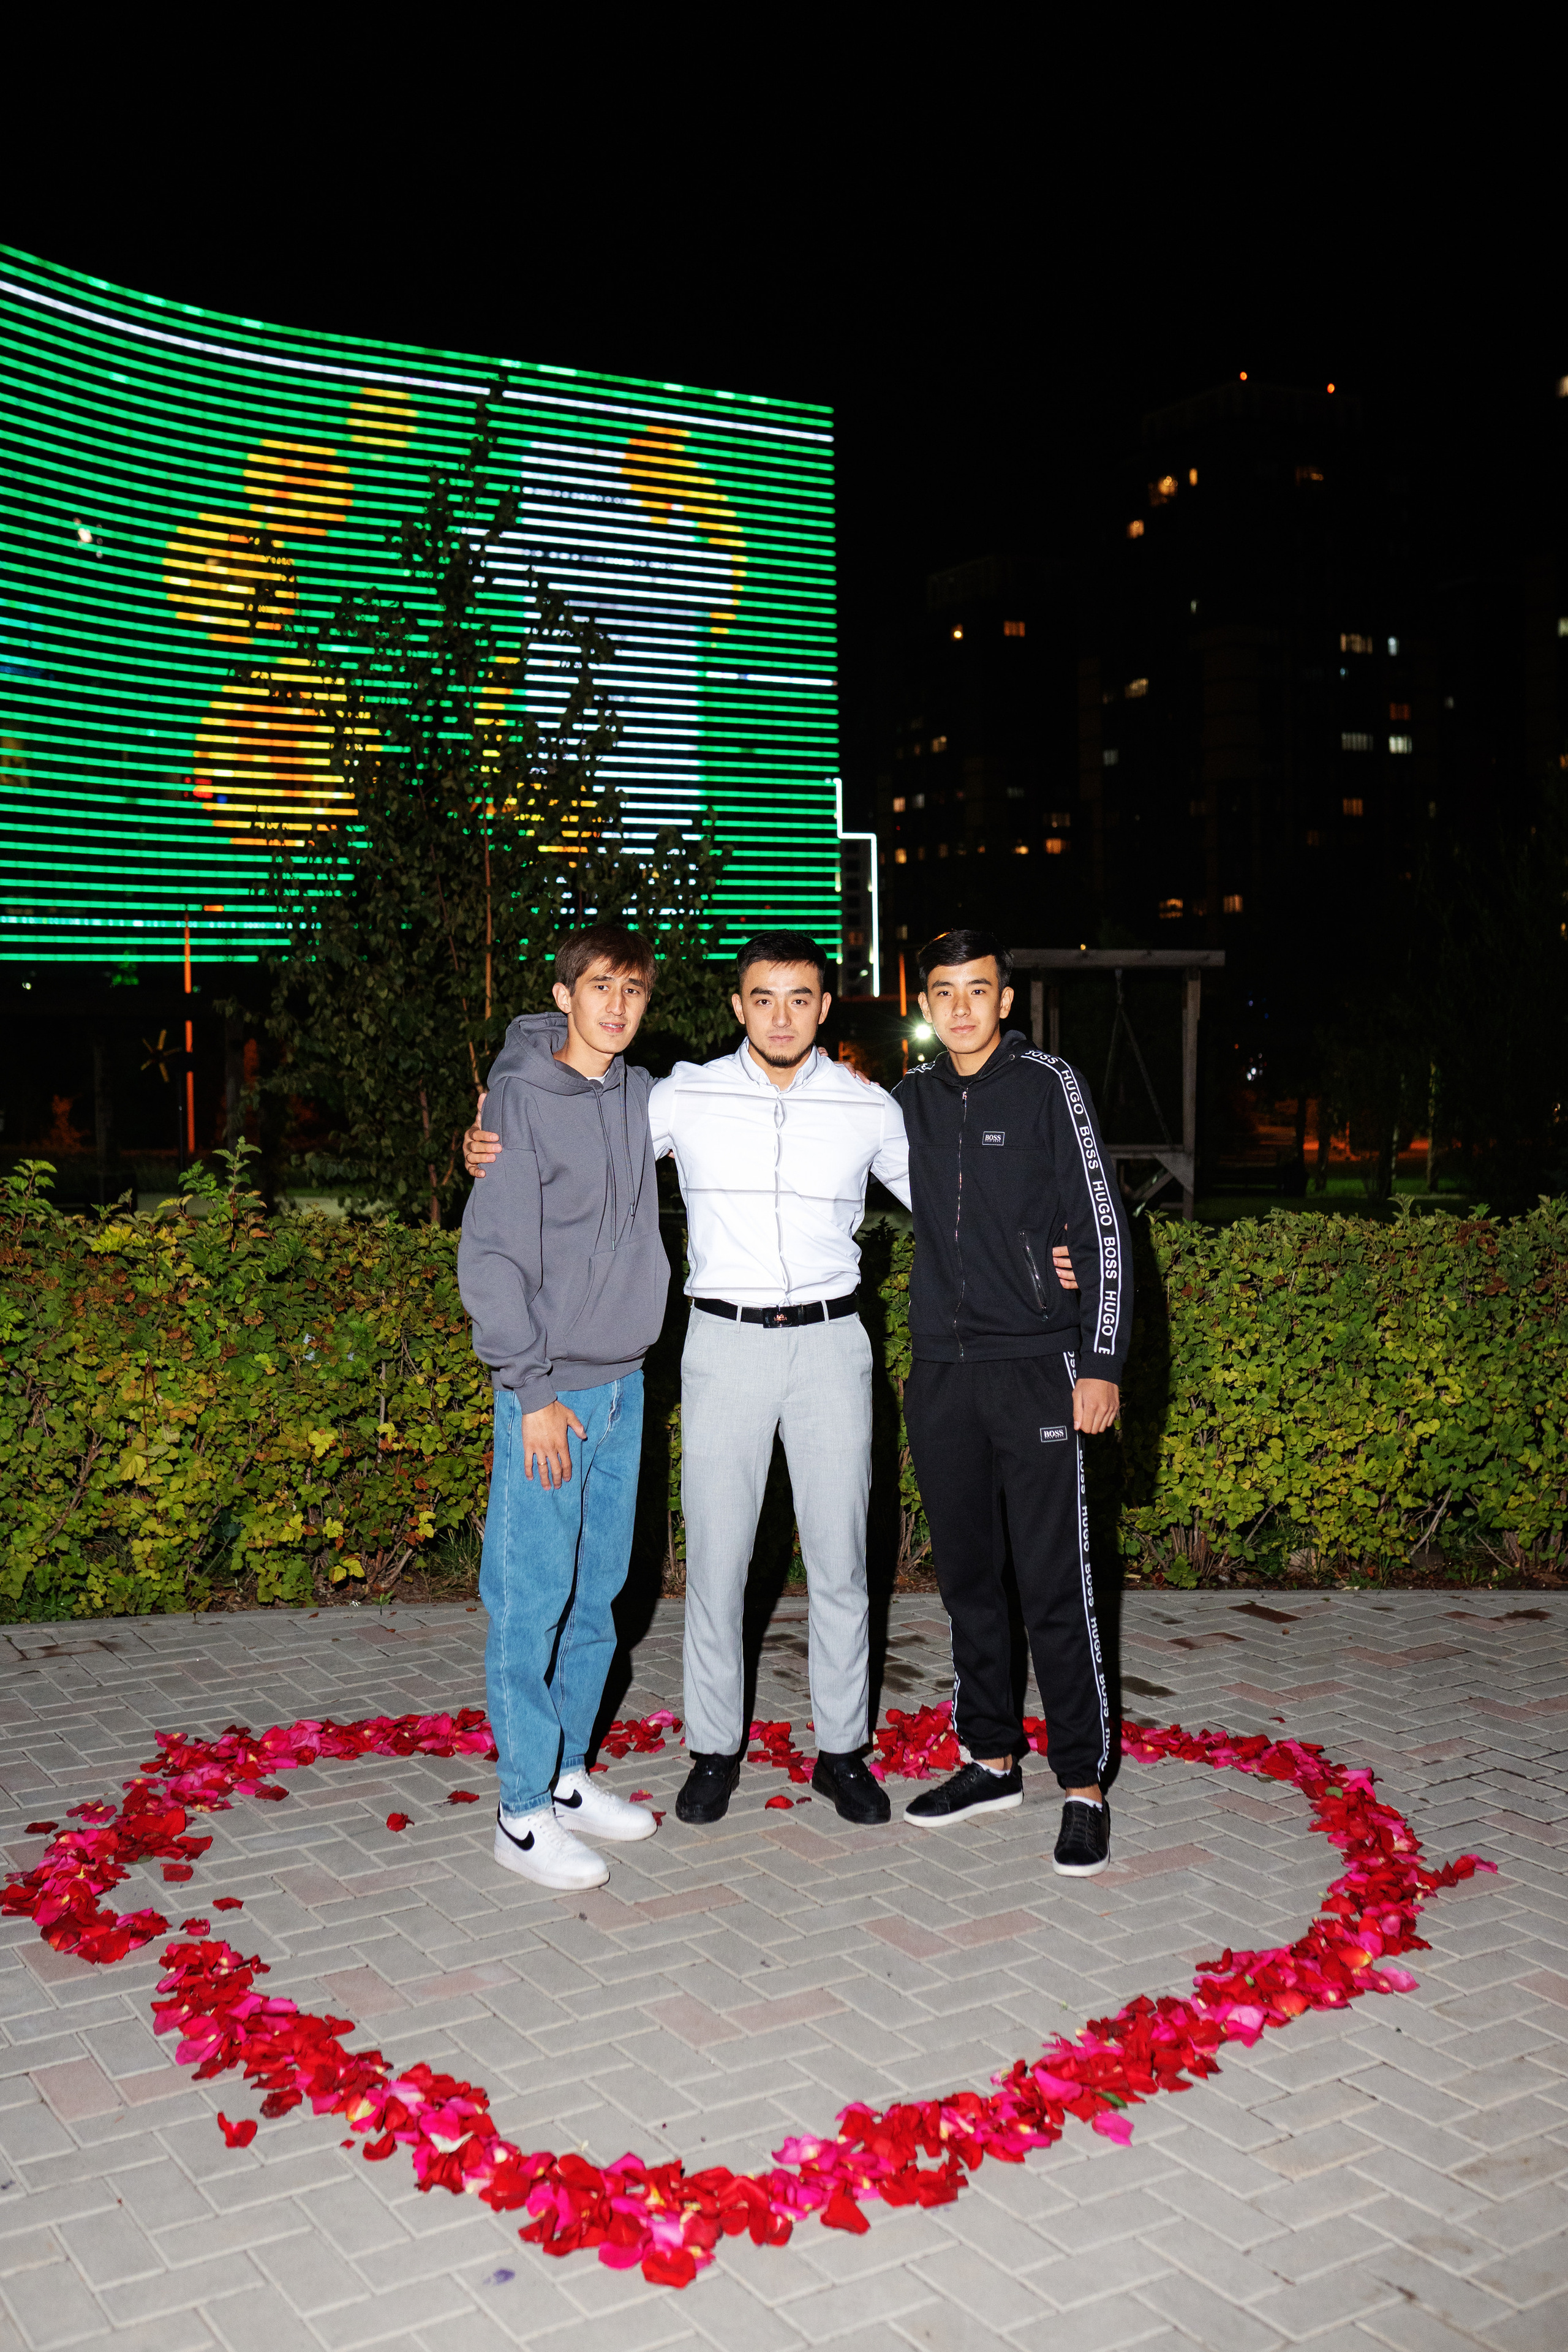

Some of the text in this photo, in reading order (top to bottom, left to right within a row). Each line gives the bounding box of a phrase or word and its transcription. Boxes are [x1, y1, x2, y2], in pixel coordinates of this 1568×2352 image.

[1061, 1069, 1084, 1115] HUGO
[1079, 1126, 1099, 1170] BOSS
[1093, 1180, 1112, 1226] HUGO
[1103, 1237, 1117, 1279] BOSS
[1101, 1291, 1117, 1336] HUGO
[1044, 1429, 1064, 1438] BOSS
[1085, 1562, 1095, 1607] BOSS
[1090, 1616, 1102, 1663] HUGO
